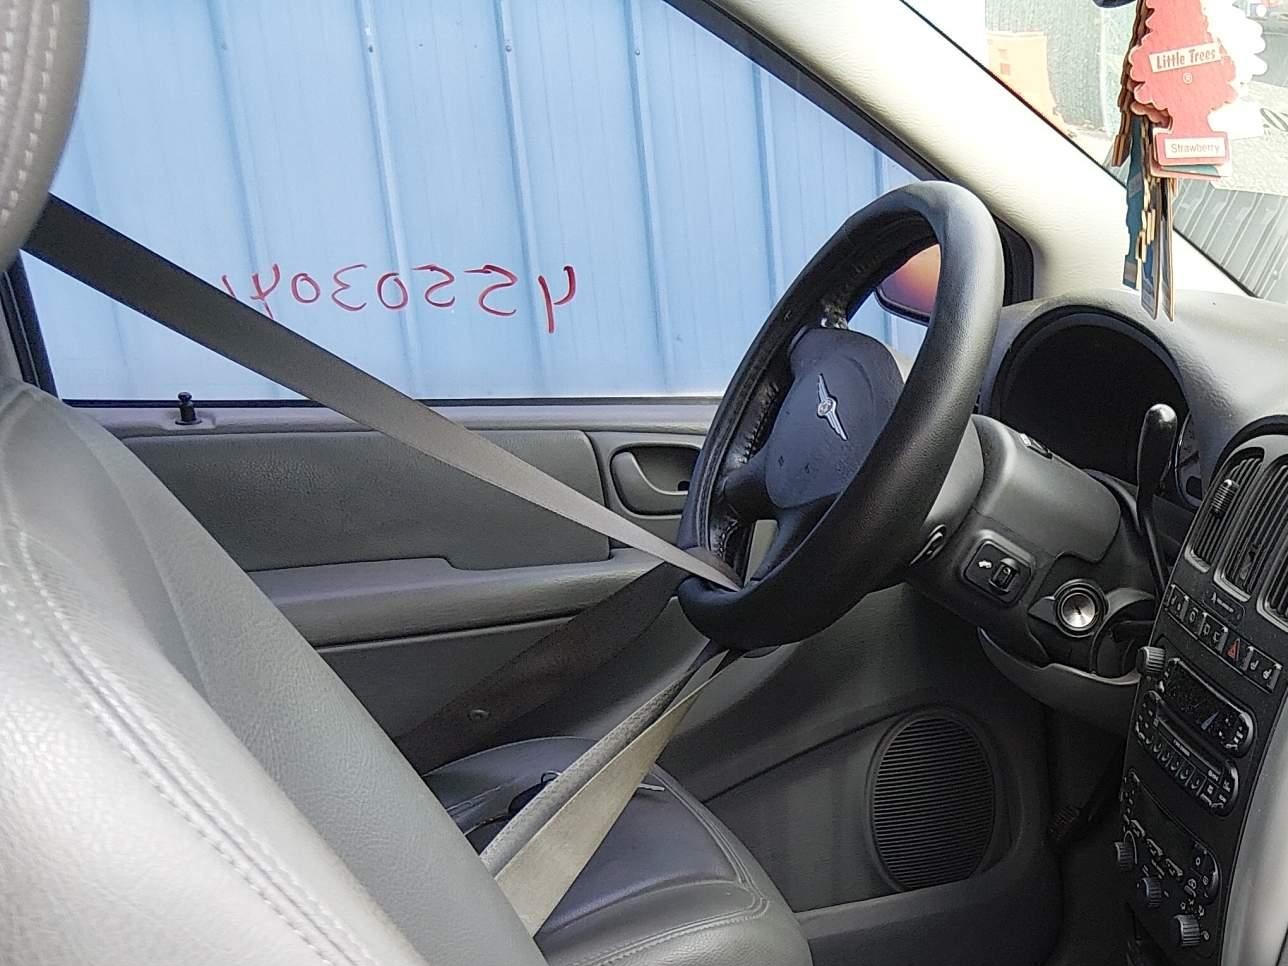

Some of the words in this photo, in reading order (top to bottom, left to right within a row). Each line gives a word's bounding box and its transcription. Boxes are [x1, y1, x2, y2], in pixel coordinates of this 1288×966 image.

[1155, 51, 1186, 71] Little
[1188, 47, 1217, 64] Trees
[1170, 142, 1221, 155] Strawberry
